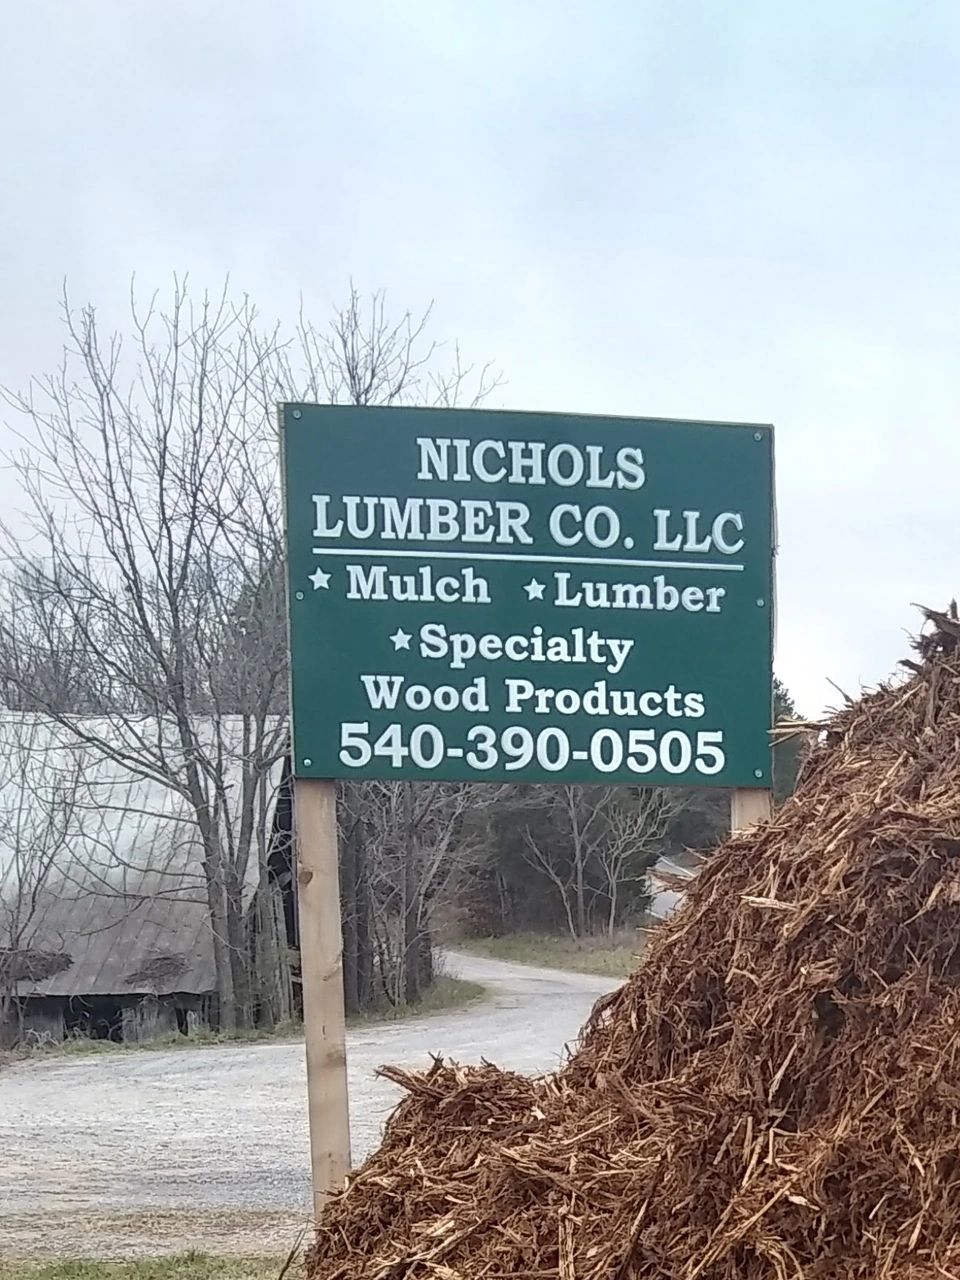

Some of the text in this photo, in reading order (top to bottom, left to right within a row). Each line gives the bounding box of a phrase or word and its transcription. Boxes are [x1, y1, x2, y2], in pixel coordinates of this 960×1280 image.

[417, 438, 646, 490] NICHOLS
[311, 494, 745, 555] LUMBER CO. LLC
[346, 564, 726, 613] Mulch Lumber
[419, 623, 635, 674] Specialty
[360, 674, 705, 718] Wood Products
[339, 721, 725, 775] 540-390-0505
